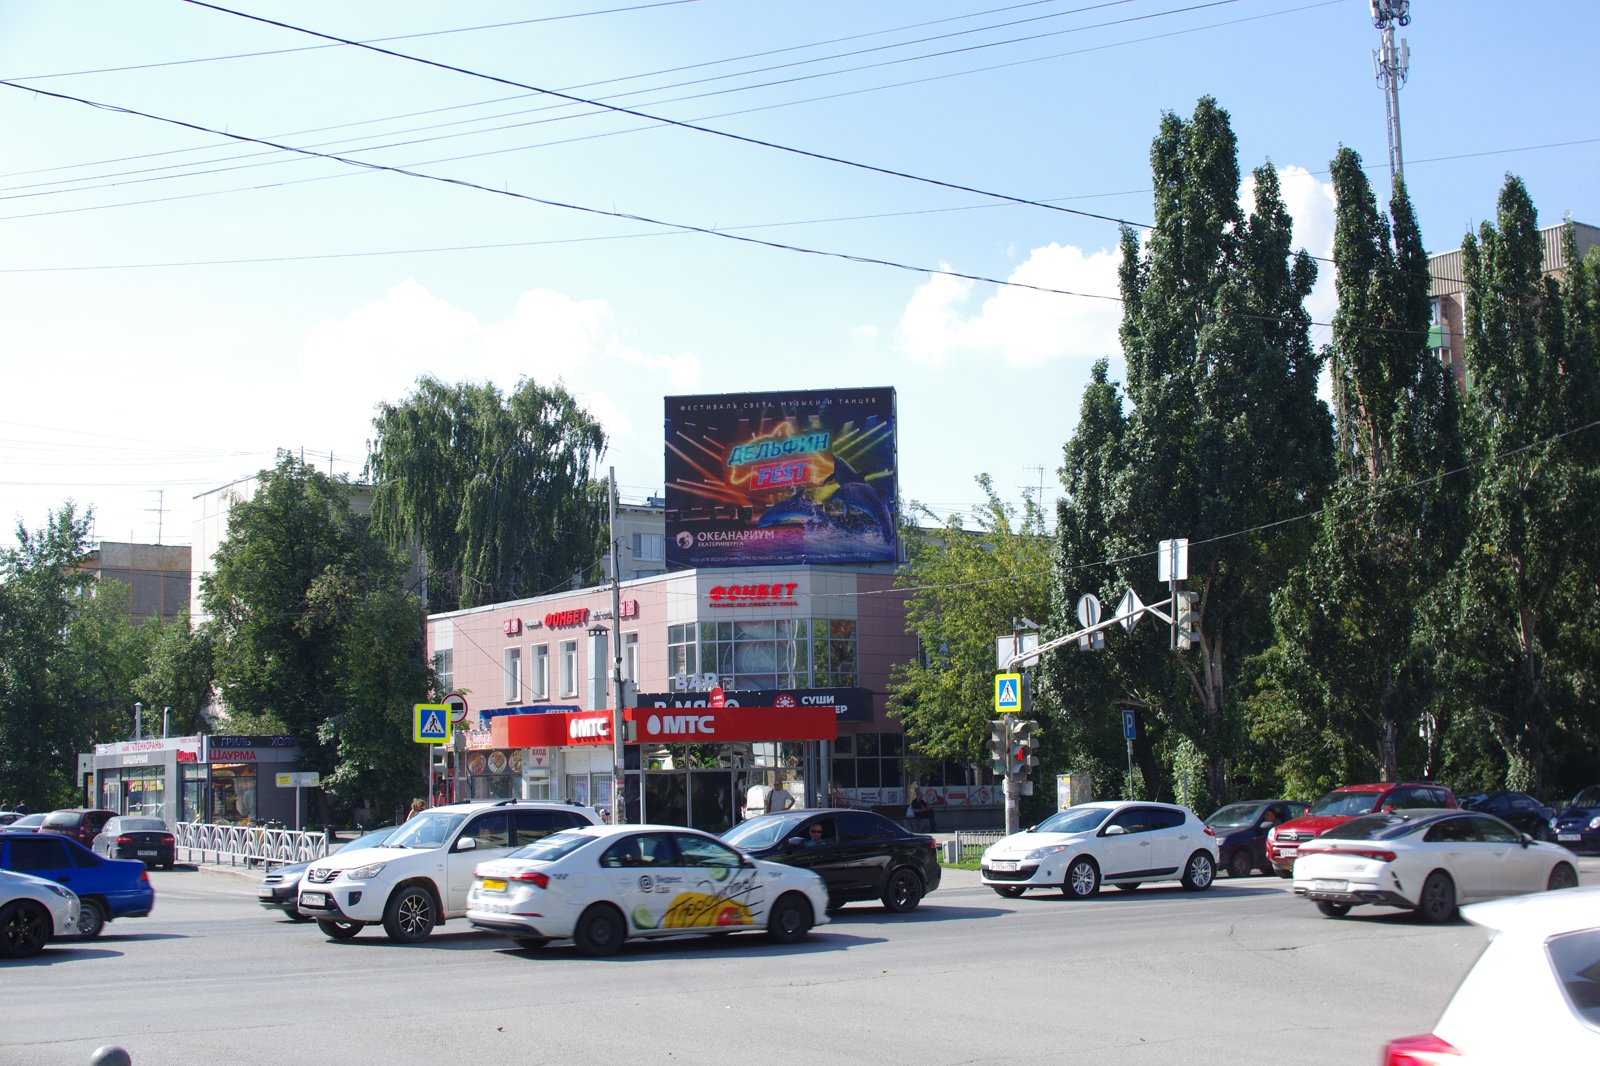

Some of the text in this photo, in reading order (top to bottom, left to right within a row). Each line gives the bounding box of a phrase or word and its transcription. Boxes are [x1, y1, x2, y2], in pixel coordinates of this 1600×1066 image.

[680, 403, 737, 411] ФЕСТИВАЛЬ
[727, 433, 830, 466] ДЕЛЬФИН
[757, 462, 808, 484] FEST
[697, 530, 775, 541] ОКЕАНАРИУМ
[709, 583, 798, 601] ФОНБЕТ
[545, 608, 588, 627] ФОНБЕТ
[675, 673, 718, 690] BAR
[801, 695, 834, 705] СУШИ
[578, 717, 609, 738] МТС
[663, 715, 715, 734] МТС
[1126, 714, 1133, 736] P
[221, 737, 252, 746] ГРИЛЬ
[532, 748, 546, 756] ВХОД
